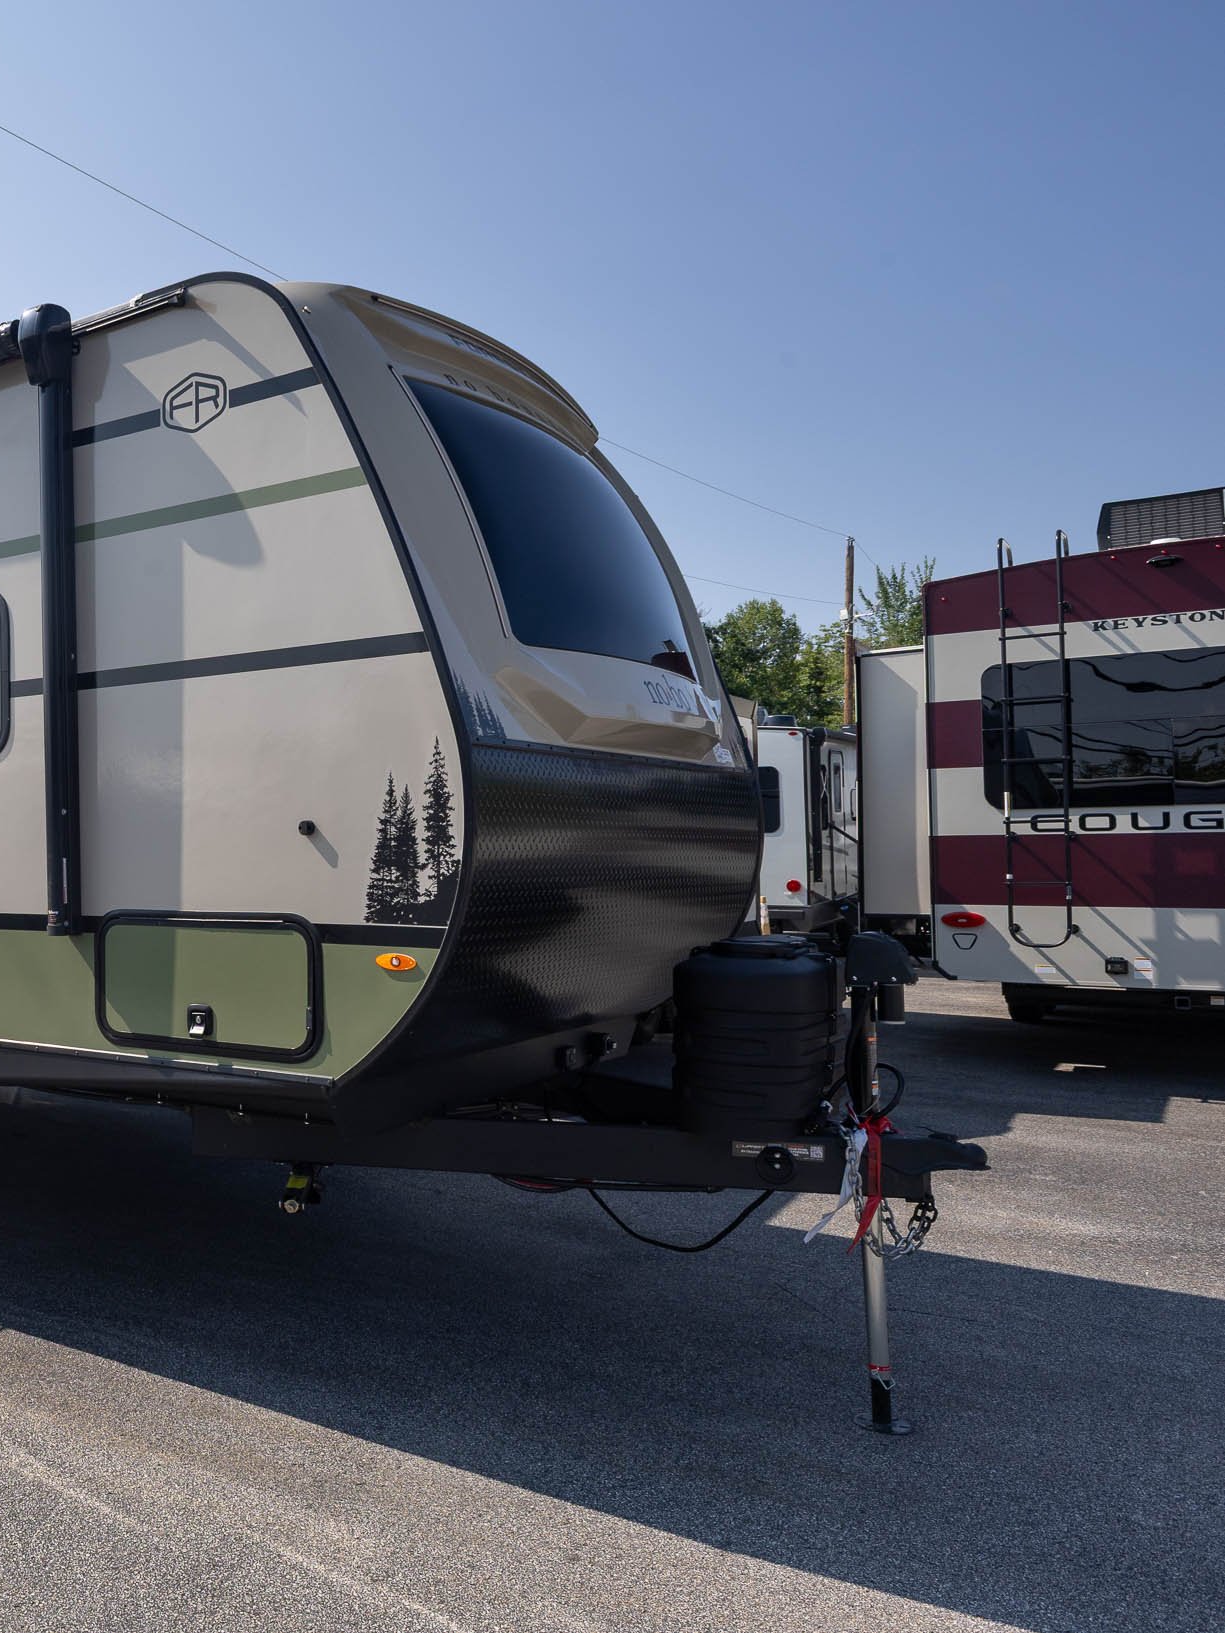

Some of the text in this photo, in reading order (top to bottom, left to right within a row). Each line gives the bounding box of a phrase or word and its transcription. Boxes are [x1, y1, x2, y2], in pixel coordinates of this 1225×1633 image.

[169, 380, 220, 425] FR
[1091, 609, 1225, 632] KEYSTON
[1030, 810, 1225, 833] COUG
